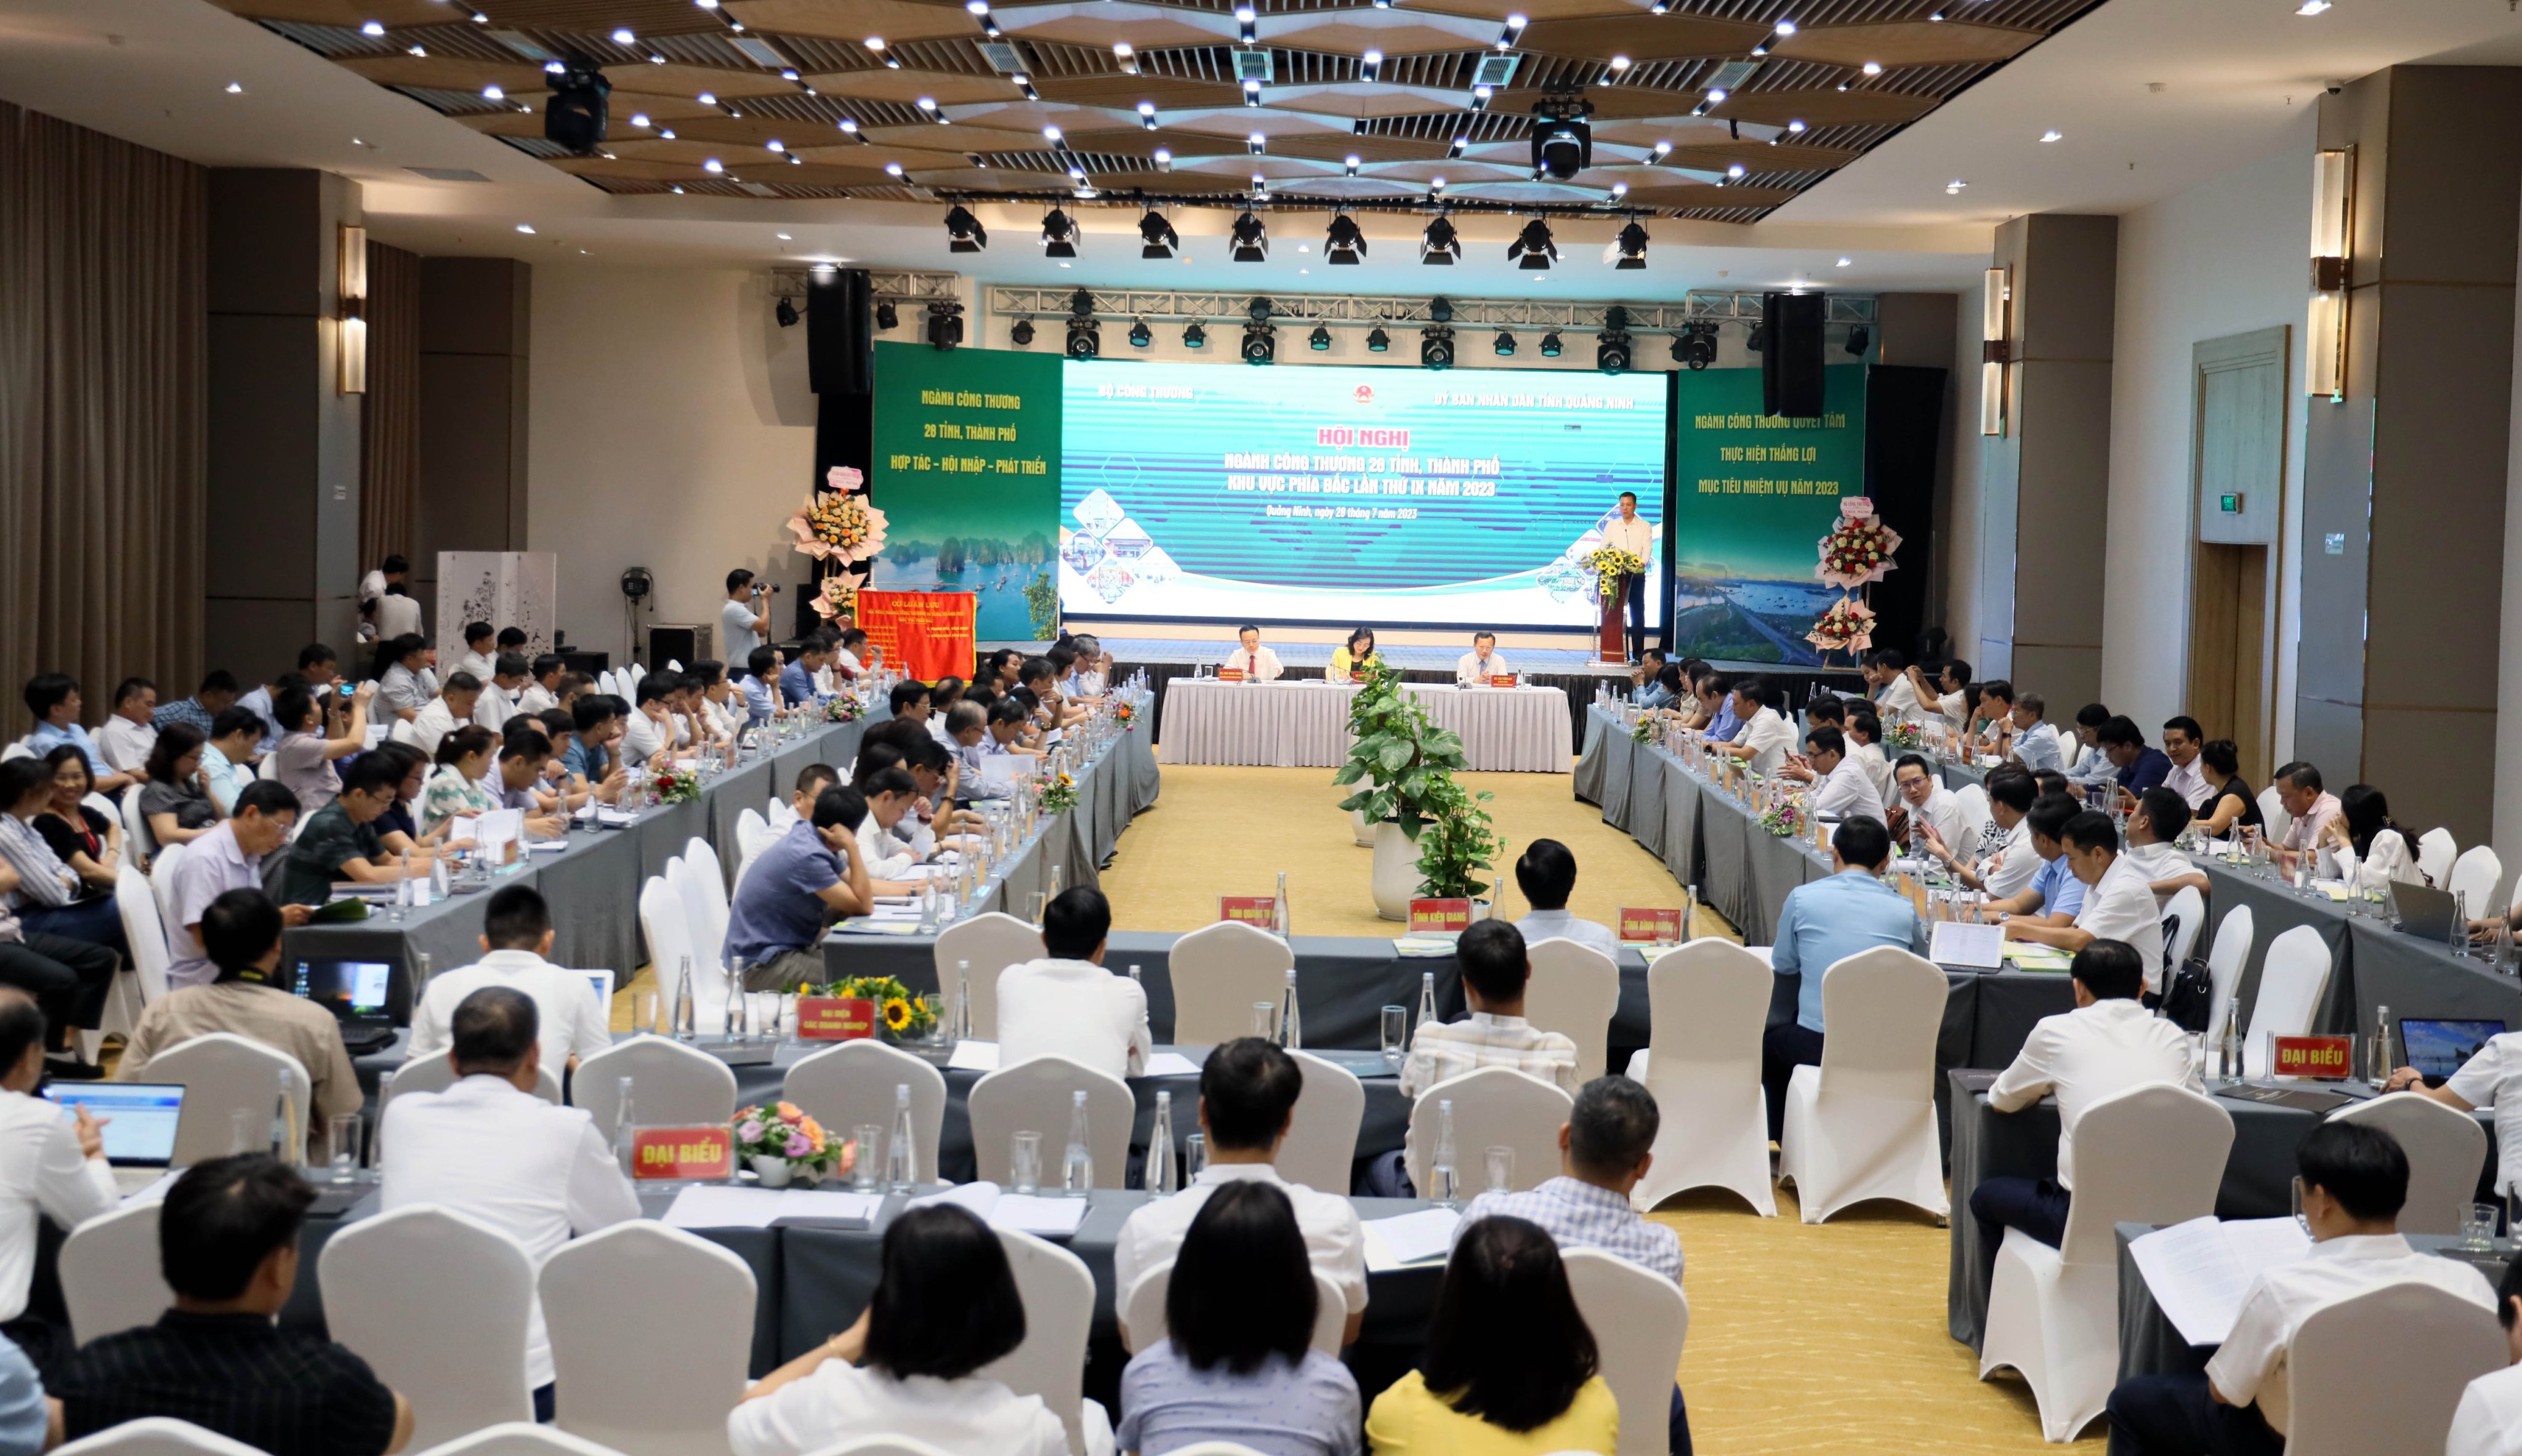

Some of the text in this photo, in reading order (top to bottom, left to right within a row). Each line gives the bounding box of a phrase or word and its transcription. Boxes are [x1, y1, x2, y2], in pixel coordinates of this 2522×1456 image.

[922, 388, 1020, 409] NGÀNH CÔNG THƯƠNG
[1098, 383, 1193, 400] BỘ CÔNG THƯƠNG
[1451, 393, 1475, 406] BAN
[1478, 392, 1509, 406] NHÂN
[1512, 393, 1535, 408] DÂN
[1538, 392, 1563, 408] TỈNH
[1566, 393, 1603, 410] QUẢNG
[1606, 396, 1634, 409] NINH
[924, 420, 1016, 441] 28 TỈNH, THÀNH PHỐ
[1695, 412, 1724, 429] NGÀNH
[1728, 412, 1751, 428] CÔNG
[1824, 411, 1845, 428] TÂM
[1318, 424, 1409, 451] HỘI NGHỊ
[1225, 450, 1500, 475] NGÀNH CÔNG THƯƠNG 28 TỈNH, THÀNH PHỐ
[1720, 443, 1816, 464] THỰC HIỆN THẮNG LỢI
[891, 454, 911, 472] HỢP
[913, 454, 930, 470] TÁC
[942, 455, 958, 475] HỘI
[961, 456, 985, 475] NHẬP
[996, 457, 1018, 473] PHÁT
[1021, 456, 1046, 475] TRIỂN
[1228, 473, 1496, 496] KHU VỰC PHÍA BẮC LẦN THỨ IX NĂM 2023
[1699, 477, 1839, 497] MỤC TIÊU NHIỆM VỤ NĂM 2023
[1266, 504, 1417, 520] Quảng Ninh, ngày 28 tháng 7 năm 2023
[1414, 909, 1466, 922] TỈNH KIÊN GIANG
[2282, 1044, 2342, 1067] ĐẠI BIỂU
[642, 1136, 722, 1167] ĐẠI BIỂU
